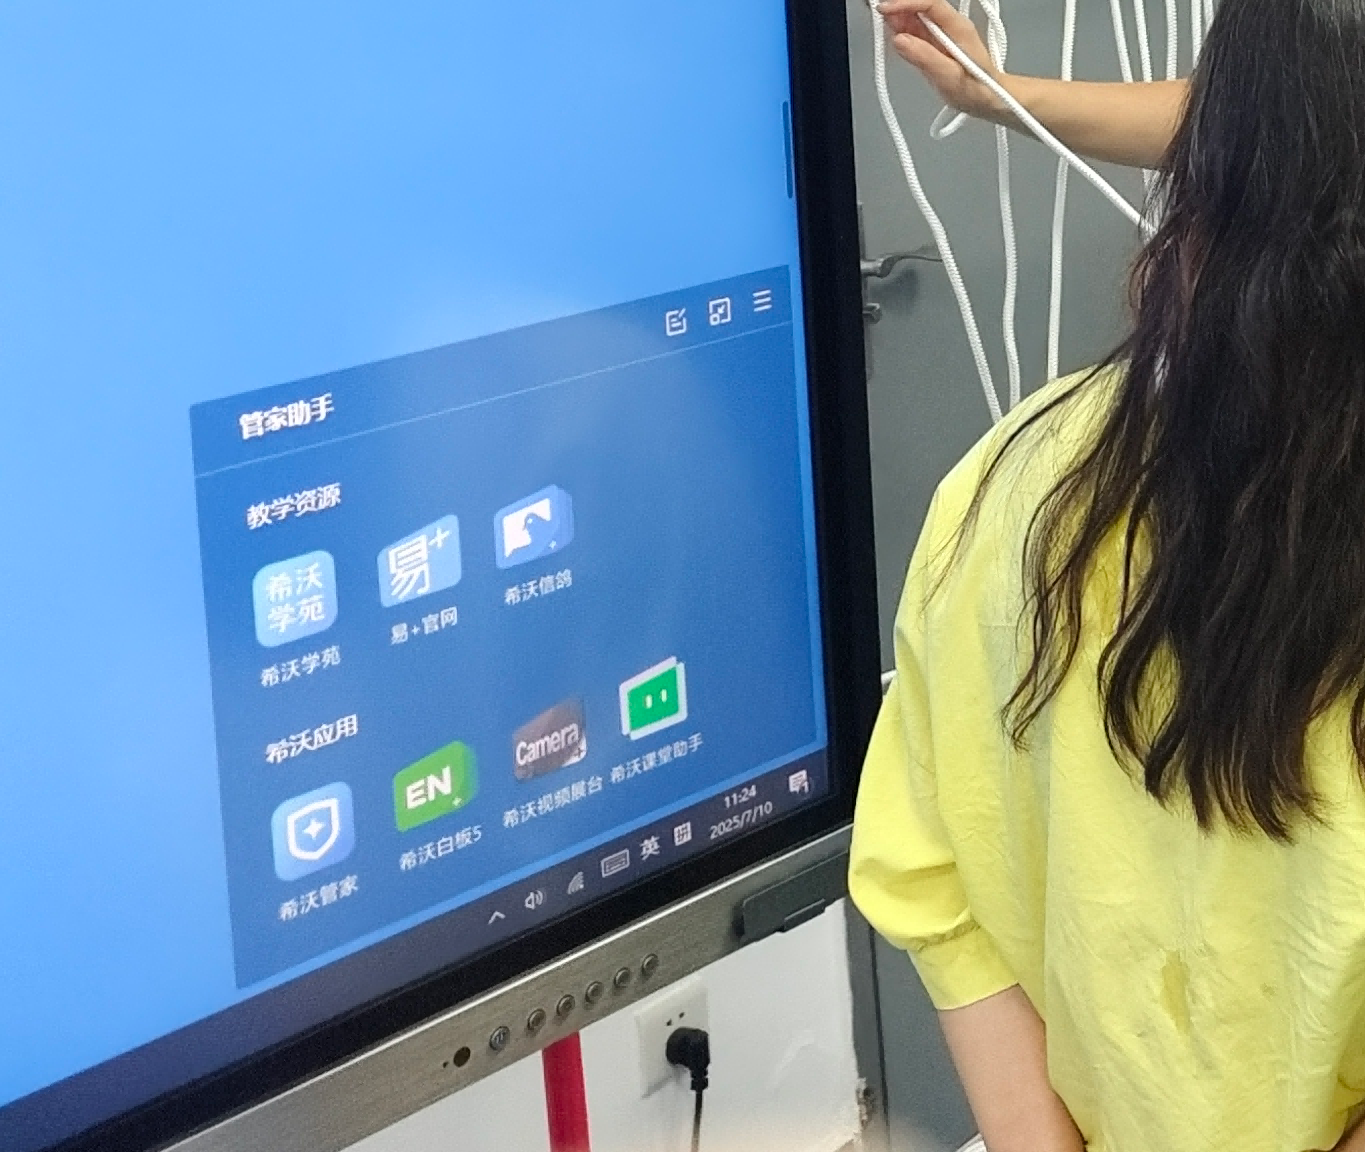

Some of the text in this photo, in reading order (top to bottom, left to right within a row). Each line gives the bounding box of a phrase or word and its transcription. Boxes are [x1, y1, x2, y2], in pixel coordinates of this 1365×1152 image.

[239, 392, 335, 440] 管家助手
[246, 482, 342, 530] 教学资源
[266, 563, 323, 603] 希沃
[504, 569, 573, 606] 希沃信鸽
[267, 598, 325, 634] 学苑
[390, 607, 458, 646] 易+官网
[260, 645, 341, 688] 希沃学苑
[265, 714, 360, 765] 希沃应用
[515, 720, 580, 768] Camera
[610, 733, 704, 786] 希沃课堂助手
[404, 766, 452, 810] EN
[502, 775, 603, 829] 希沃视频展台
[724, 786, 757, 808] 11:24
[710, 802, 773, 839] 2025/7/10
[398, 825, 483, 872] 希沃白板5
[640, 836, 660, 860] 英
[278, 874, 360, 922] 希沃管家
